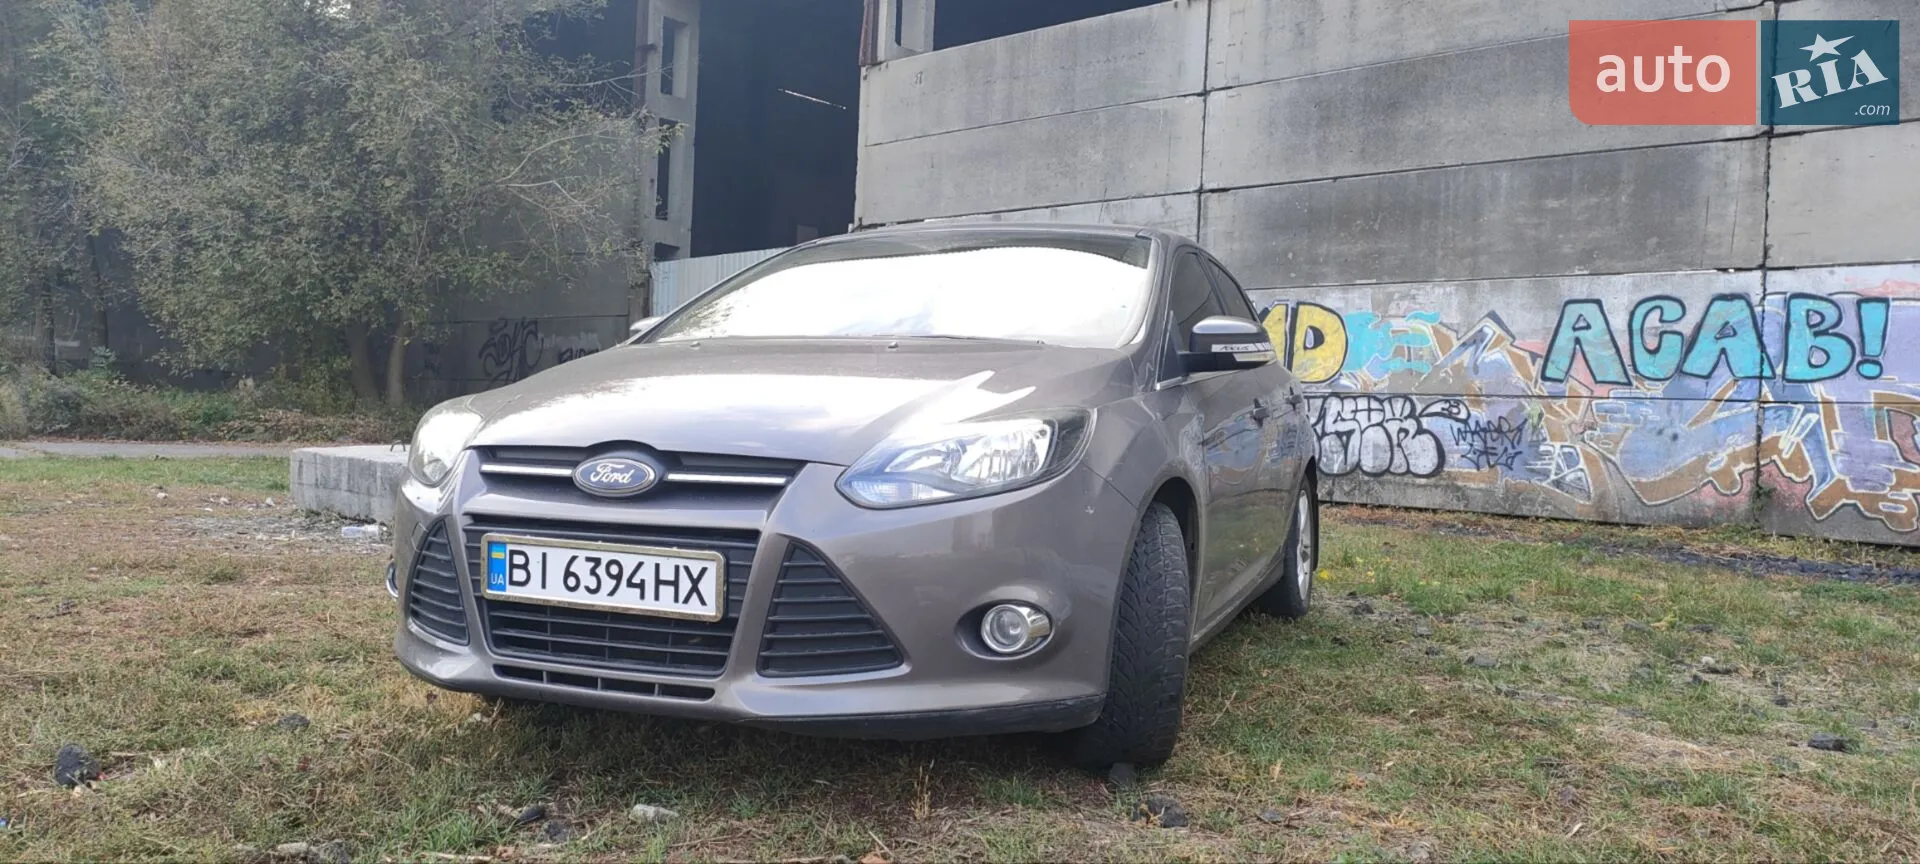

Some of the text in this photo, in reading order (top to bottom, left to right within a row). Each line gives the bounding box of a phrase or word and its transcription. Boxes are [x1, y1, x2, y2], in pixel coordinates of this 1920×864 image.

[1541, 293, 1893, 386] ACAB!
[590, 462, 635, 484] Ford
[490, 572, 505, 585] UA
